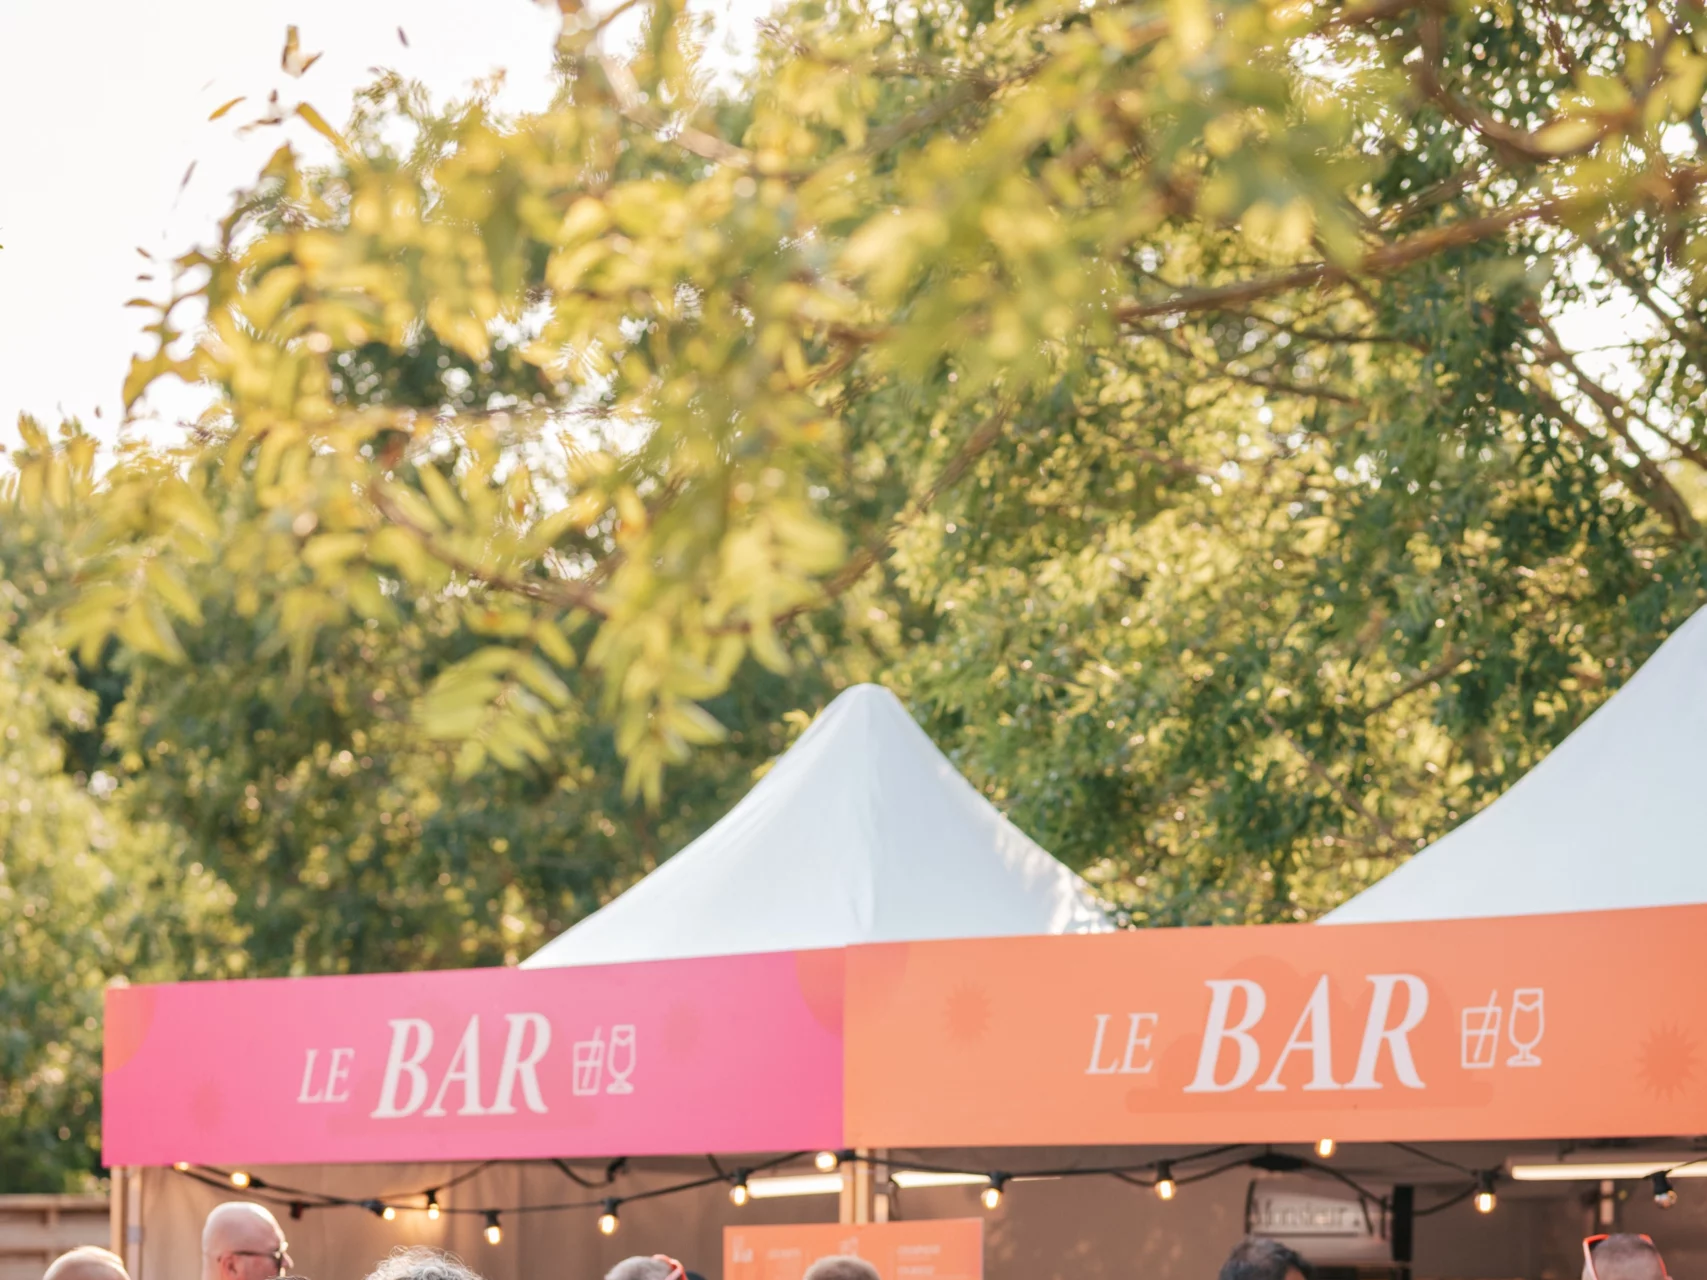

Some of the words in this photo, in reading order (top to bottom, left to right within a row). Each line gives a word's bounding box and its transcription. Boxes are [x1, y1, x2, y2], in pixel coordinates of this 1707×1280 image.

[297, 1047, 355, 1104] LE
[370, 1012, 552, 1119] BAR
[1085, 1012, 1158, 1074] LE
[1183, 974, 1429, 1093] BAR
